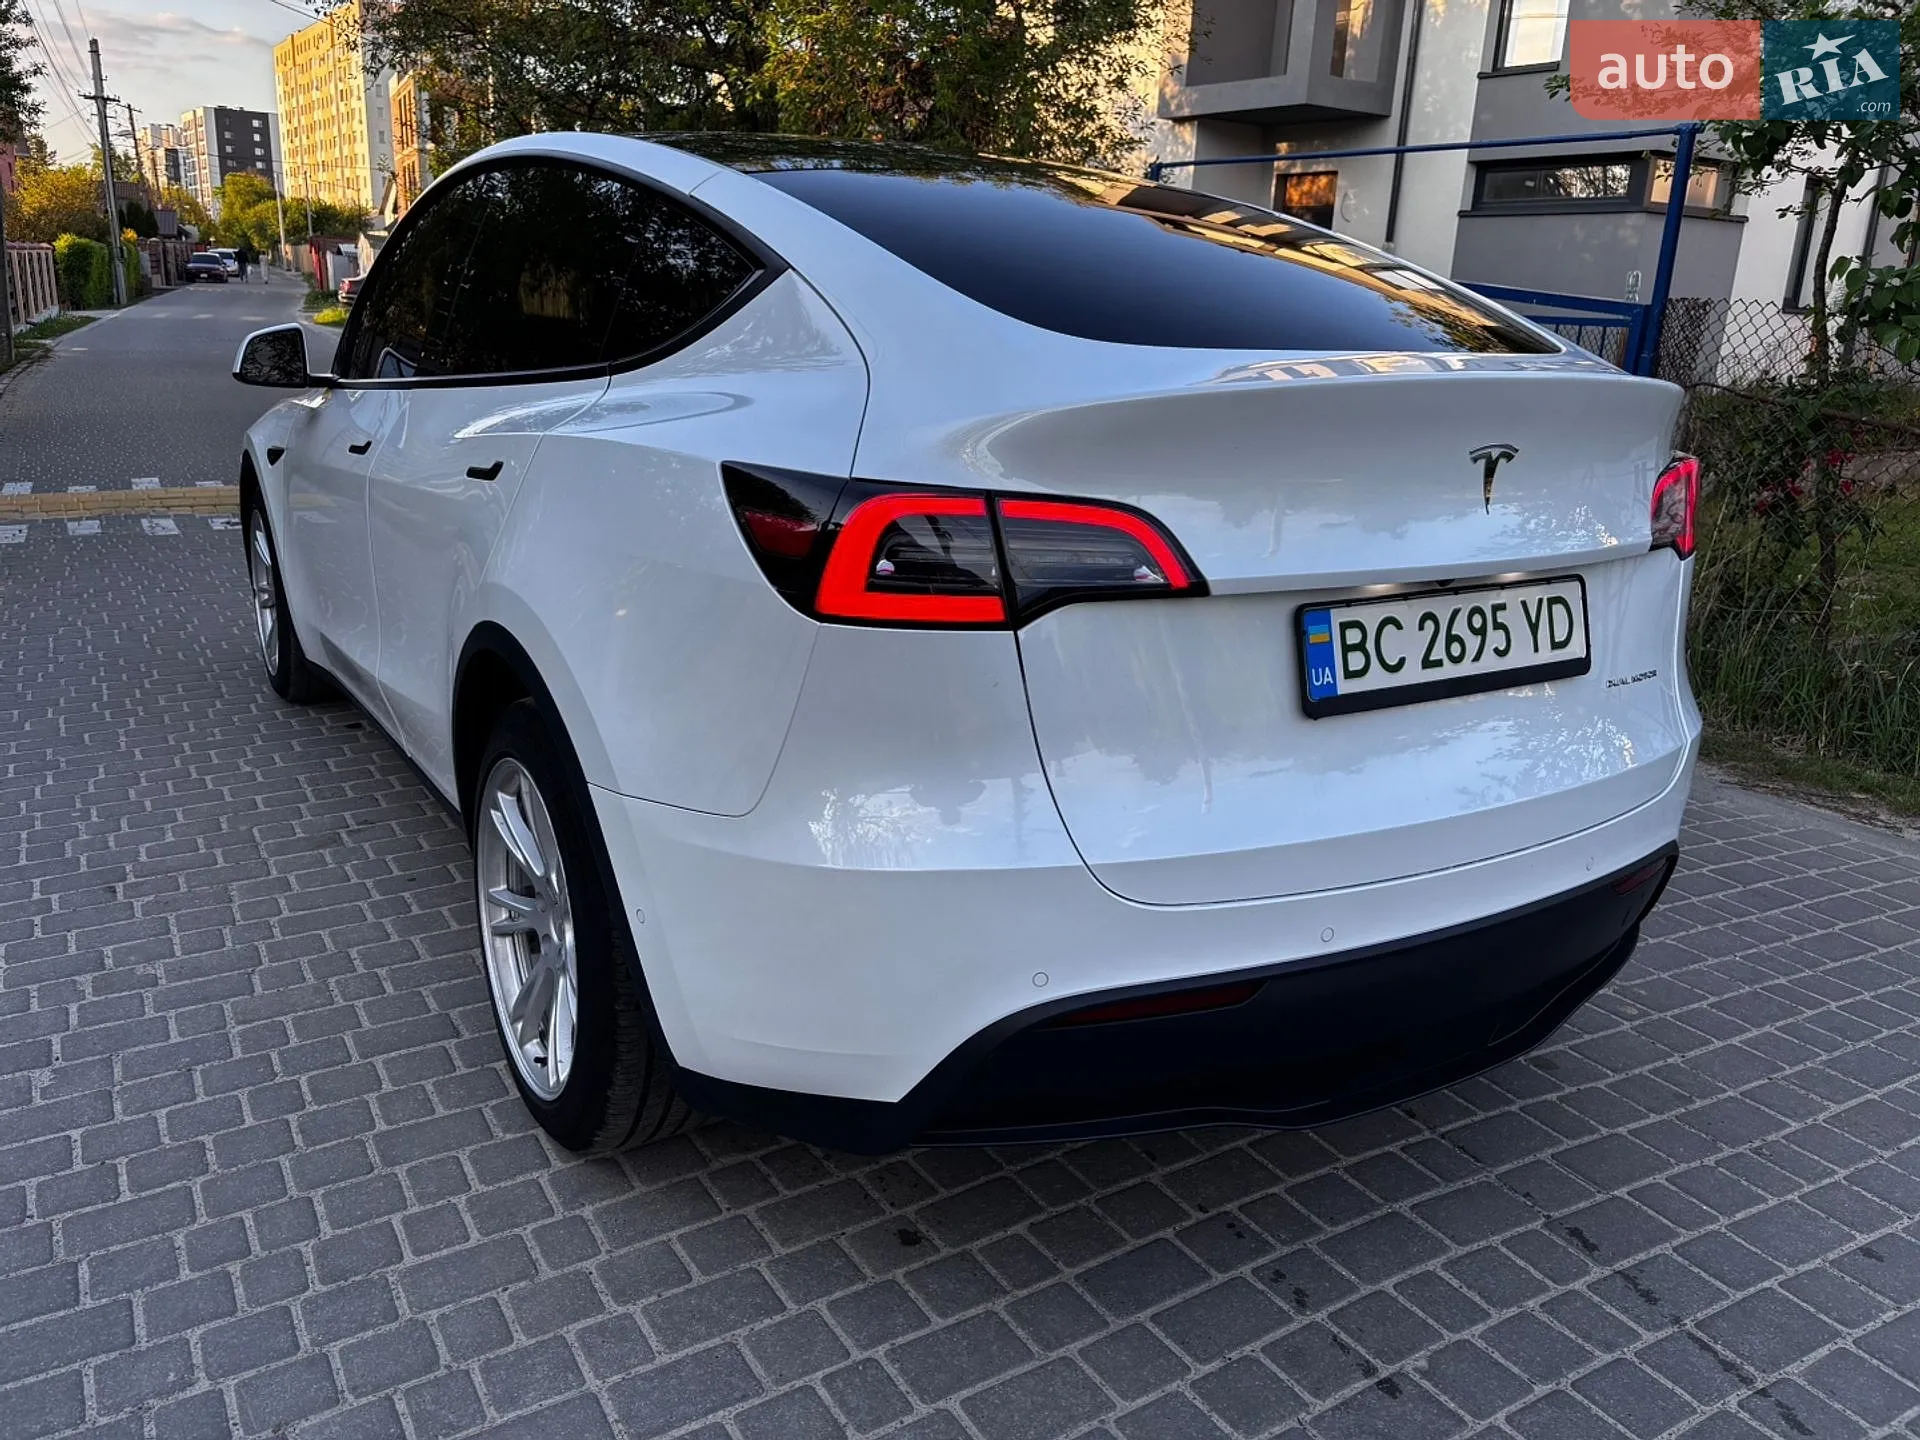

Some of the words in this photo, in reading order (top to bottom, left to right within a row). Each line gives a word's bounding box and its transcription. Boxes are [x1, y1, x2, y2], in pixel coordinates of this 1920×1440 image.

[1338, 615, 1407, 680] BC
[1418, 602, 1513, 670] 2695
[1520, 594, 1575, 654] YD
[1311, 666, 1334, 686] UA
